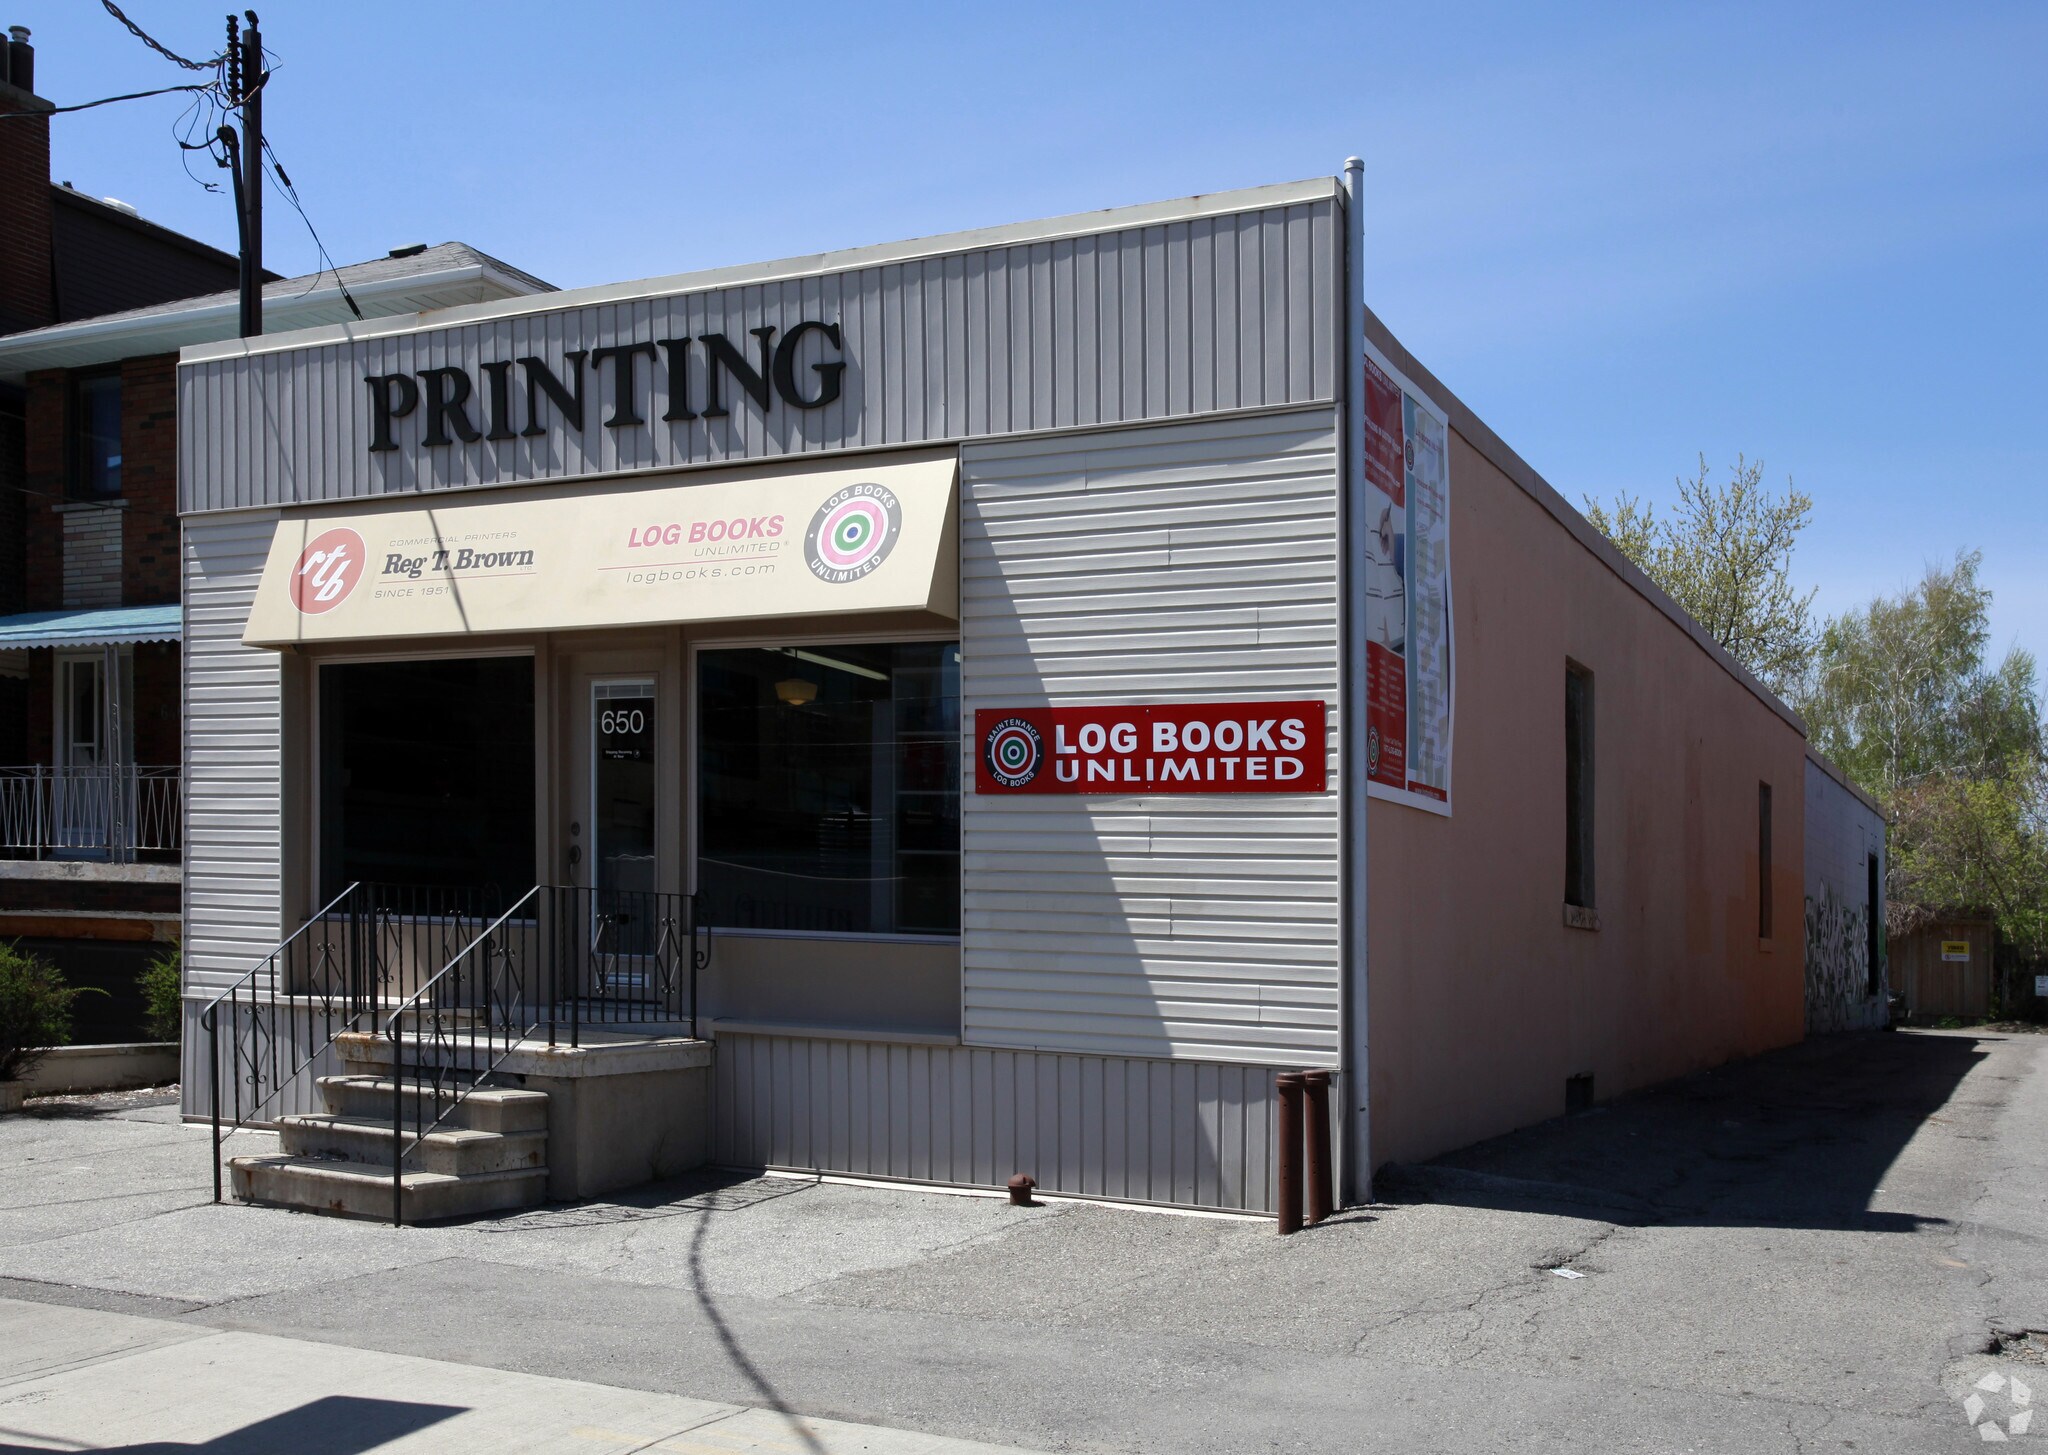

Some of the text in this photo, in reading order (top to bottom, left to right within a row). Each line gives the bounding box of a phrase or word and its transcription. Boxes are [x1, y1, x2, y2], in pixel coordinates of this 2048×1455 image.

[364, 320, 847, 452] PRINTING
[821, 484, 896, 515] LOG BOOKS
[389, 531, 517, 547] COMMERCIAL PRINTERS
[628, 514, 785, 548] LOG BOOKS
[381, 553, 428, 578] Reg
[453, 548, 534, 570] Brown
[626, 562, 776, 585] logbooks.com
[810, 554, 882, 583] UNLIMITED
[374, 586, 450, 599] SINCE 1951
[601, 709, 644, 734] 650
[987, 718, 1041, 743] MAINTENANCE
[1055, 718, 1306, 755] LOG BOOKS
[993, 771, 1035, 787] LOG BOOKS
[1055, 756, 1305, 783] UNLIMITED
